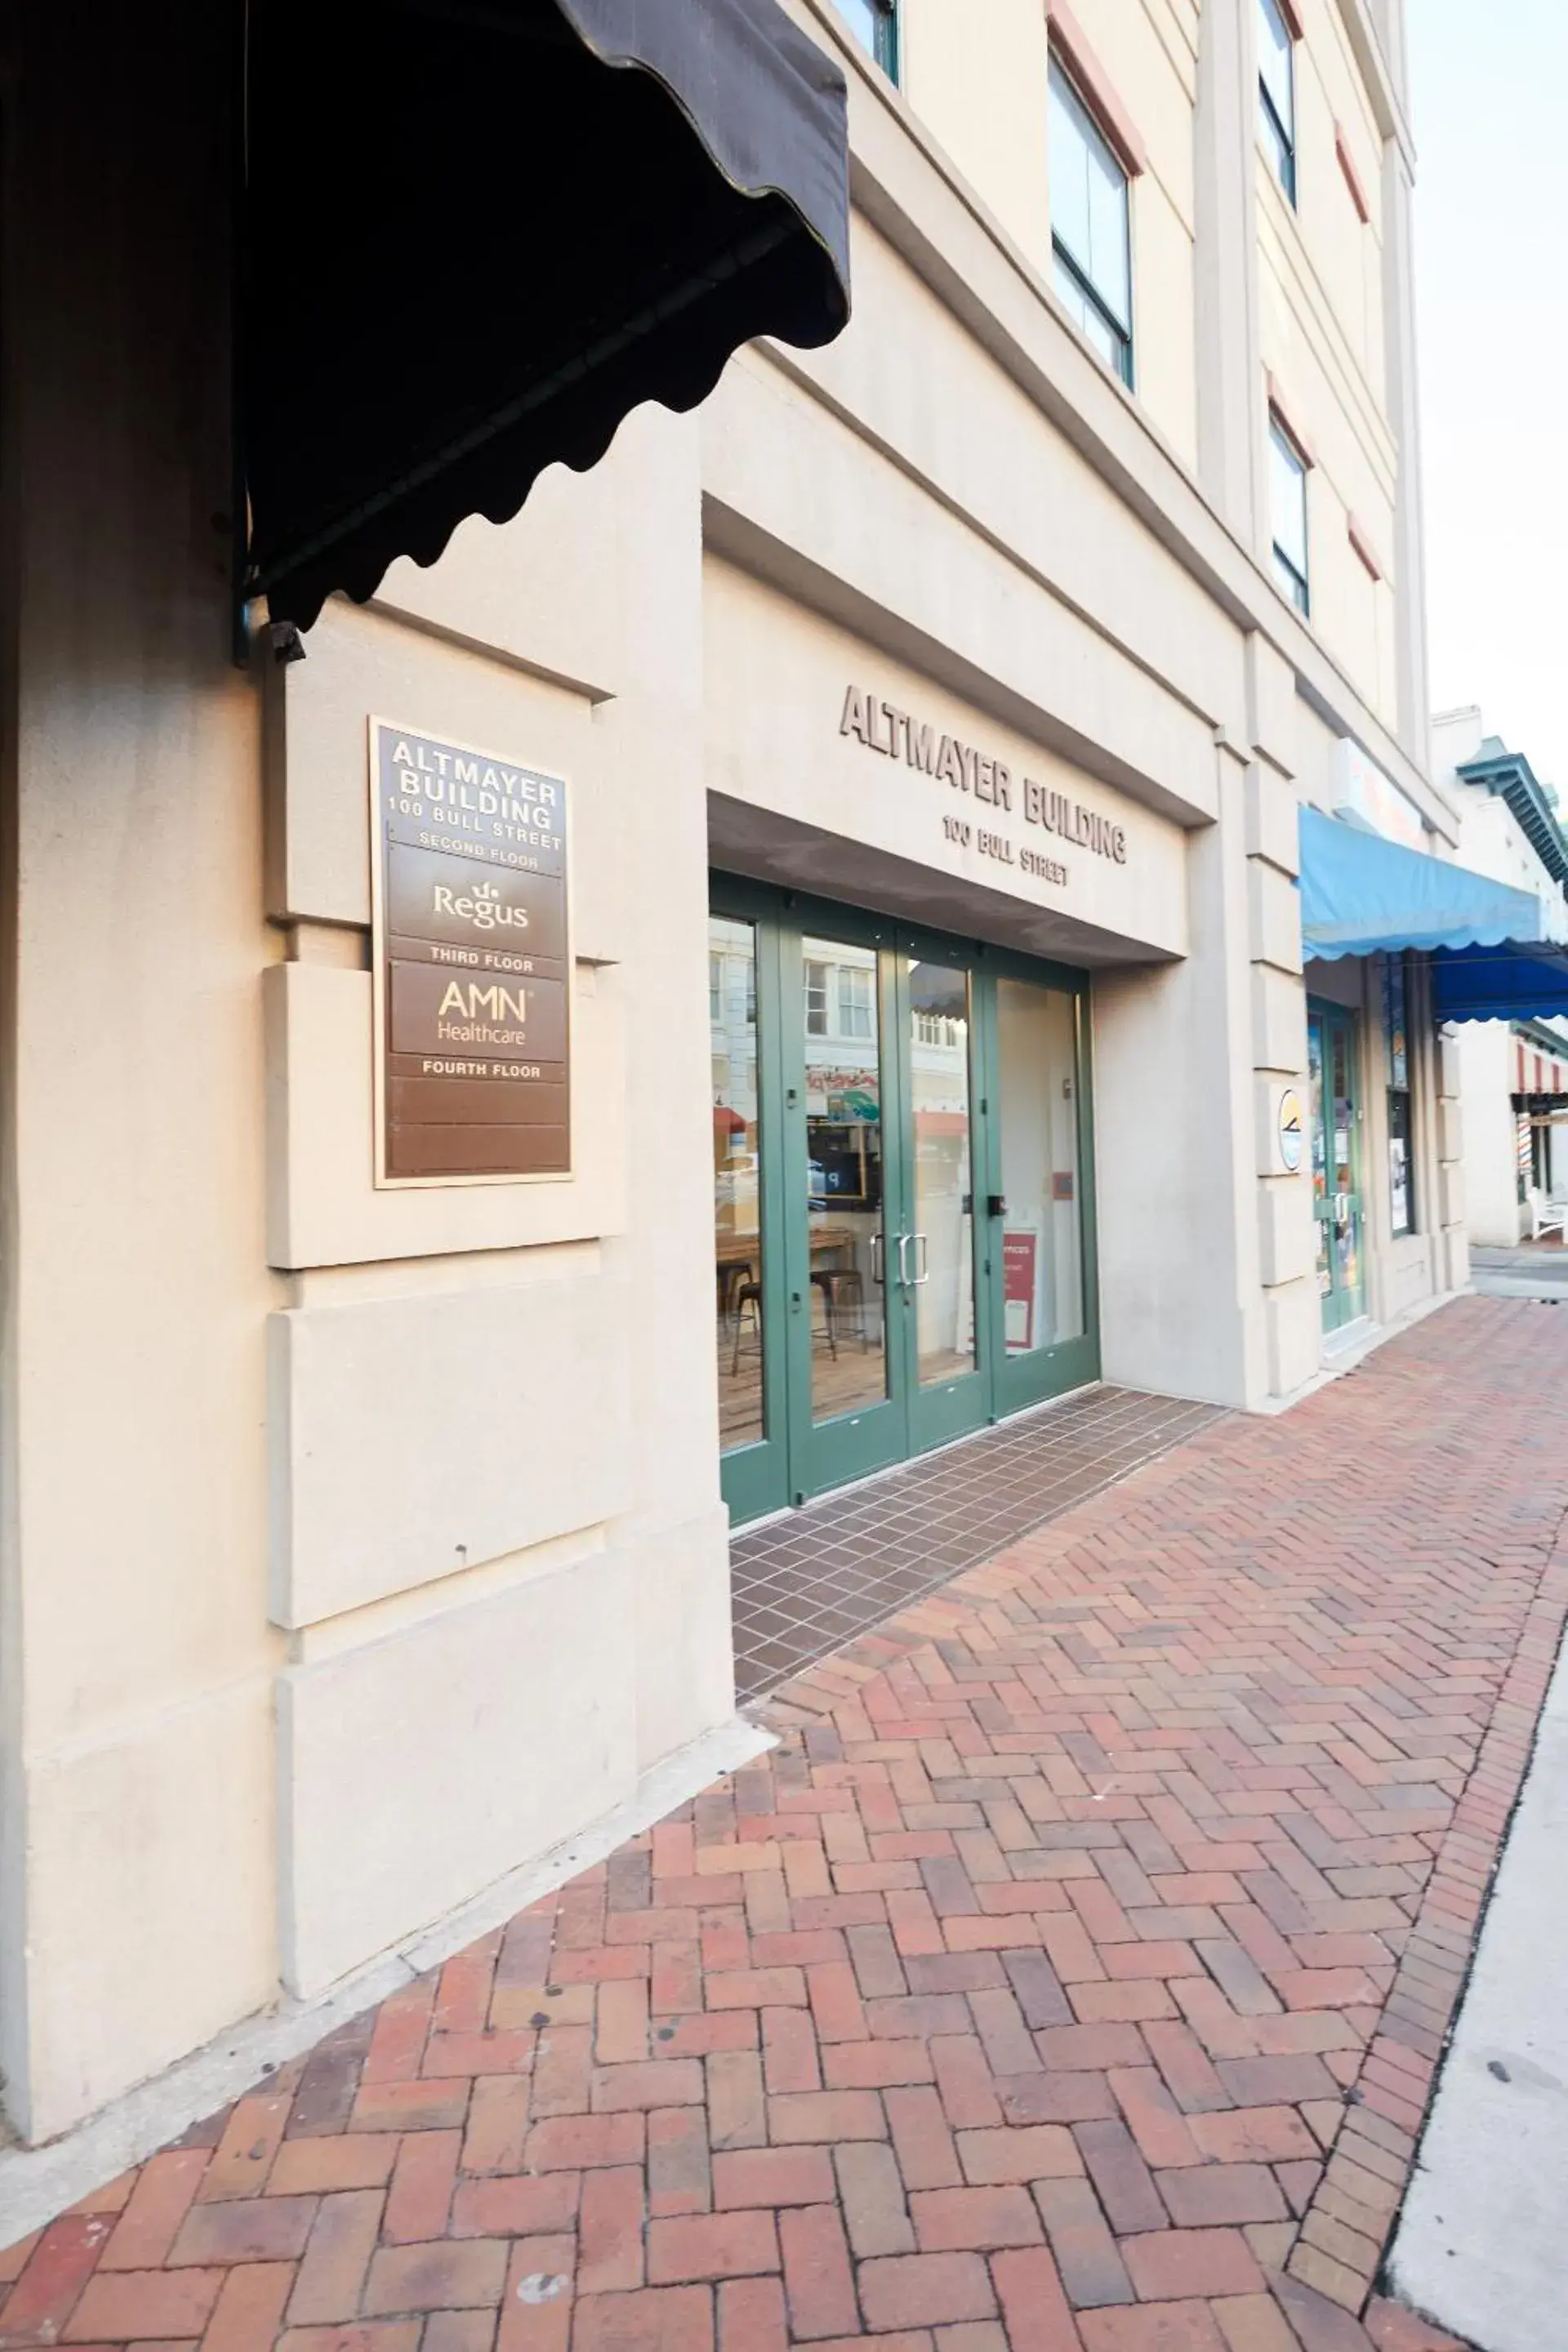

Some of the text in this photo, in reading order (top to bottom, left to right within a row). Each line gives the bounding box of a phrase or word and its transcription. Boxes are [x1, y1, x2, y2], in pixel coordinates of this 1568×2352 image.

[392, 741, 556, 806] ALTMAYER
[840, 685, 1126, 864] ALTMAYER BUILDING
[400, 769, 550, 830] BUILDING
[388, 797, 562, 850] 100 BULL STREET
[419, 831, 538, 869] SECOND FLOOR
[978, 828, 1014, 864] BULL
[1019, 847, 1067, 886] STREET
[433, 885, 528, 929] Regus
[430, 947, 534, 972] THIRD FLOOR
[438, 981, 527, 1023] AMN
[438, 1020, 526, 1045] Healthcare
[422, 1060, 541, 1078] FOURTH FLOOR
